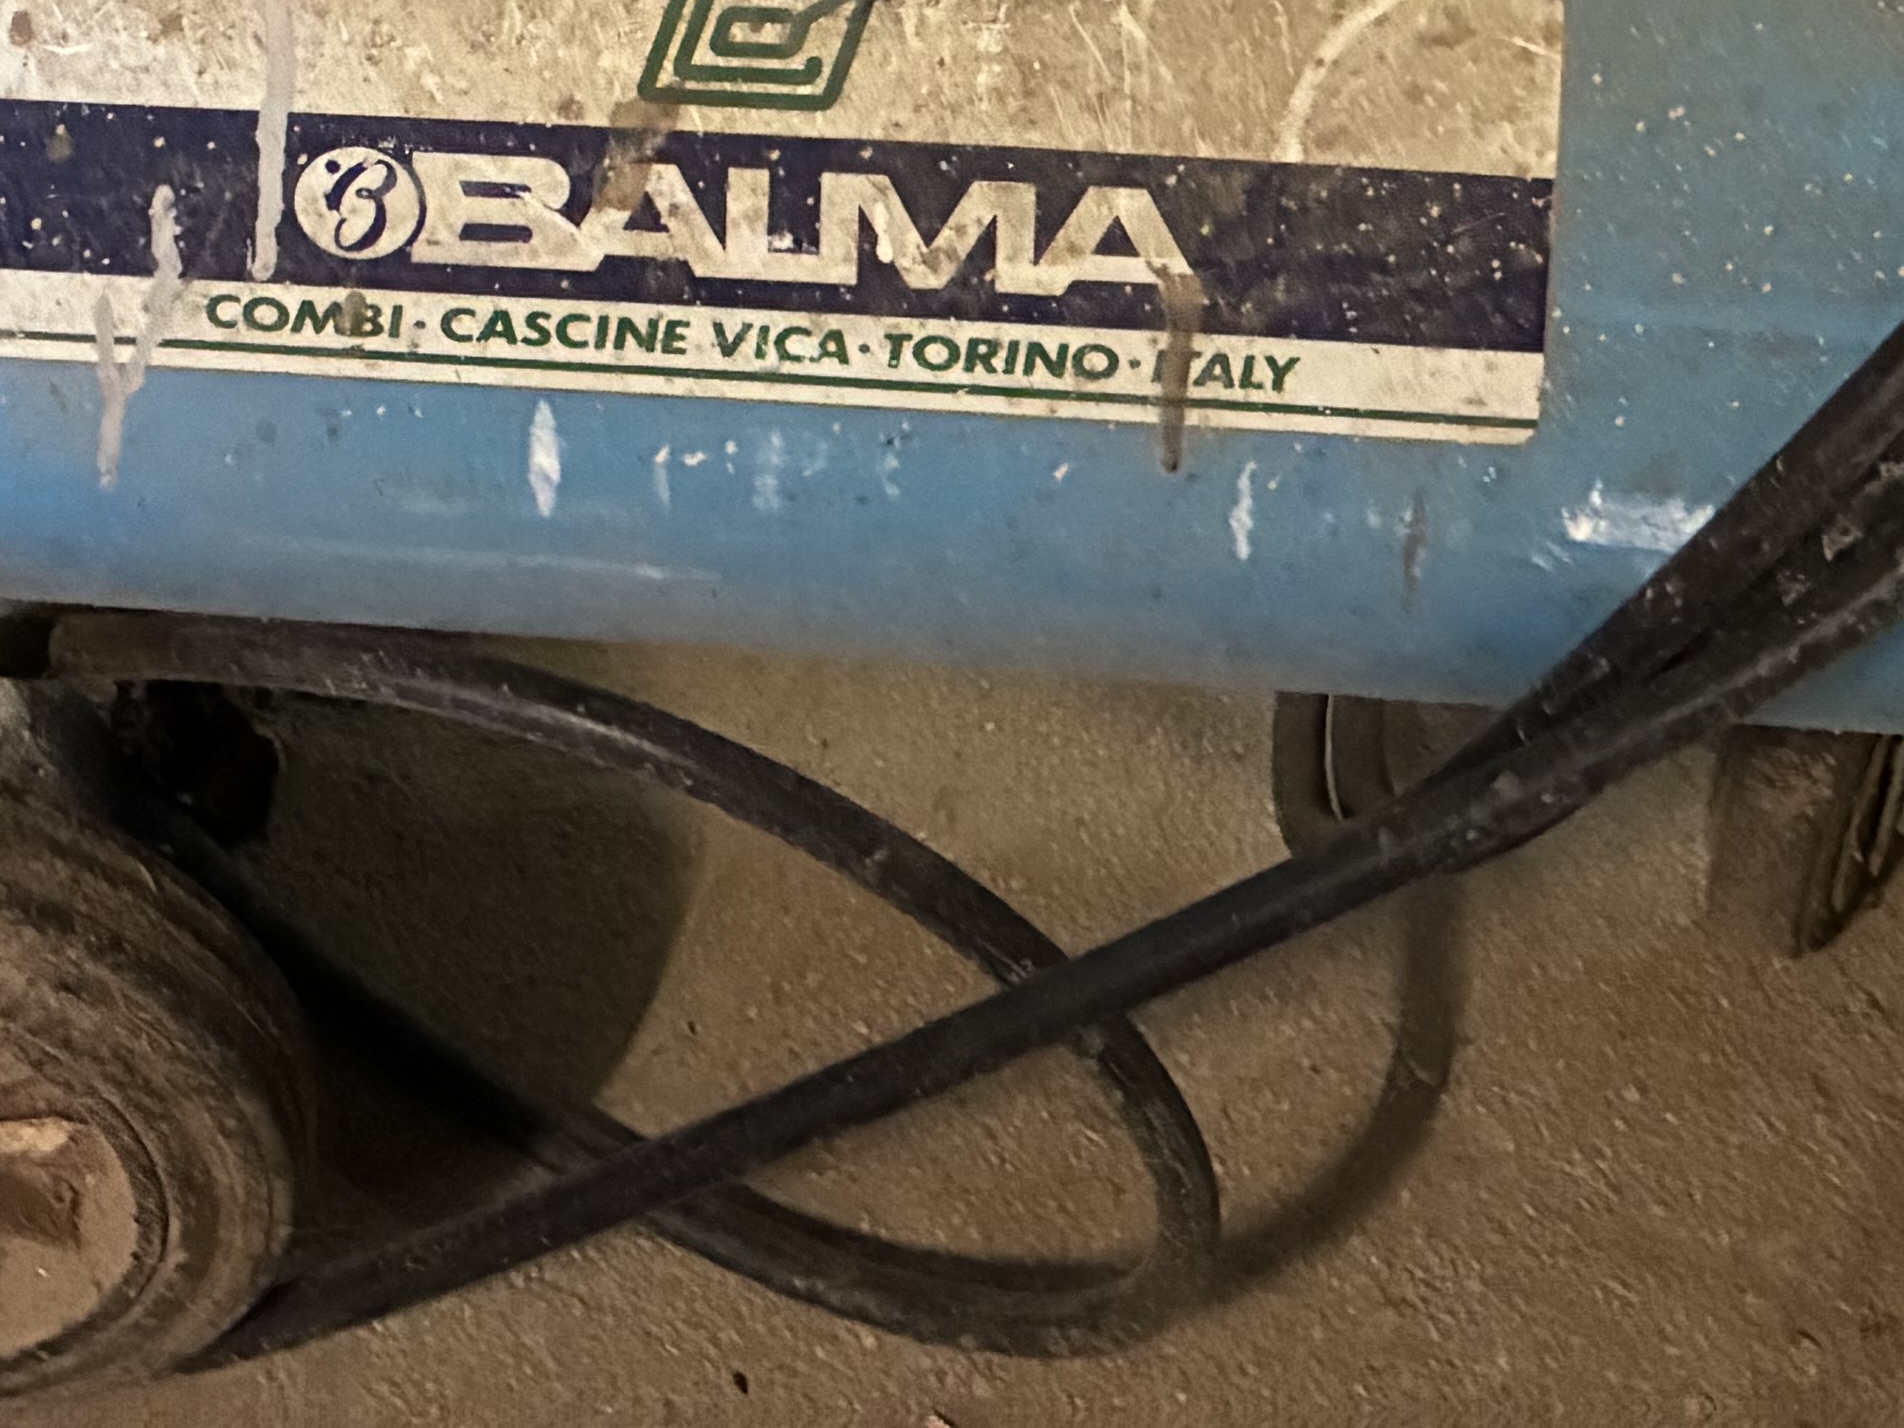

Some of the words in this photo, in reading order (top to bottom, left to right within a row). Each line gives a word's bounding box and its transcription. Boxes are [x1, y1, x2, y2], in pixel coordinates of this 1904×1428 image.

[410, 151, 1196, 297] BALMA
[205, 293, 404, 339] COMBI
[439, 306, 689, 356] CASCINE
[711, 320, 850, 366] VICA
[884, 331, 1121, 381] TORINO
